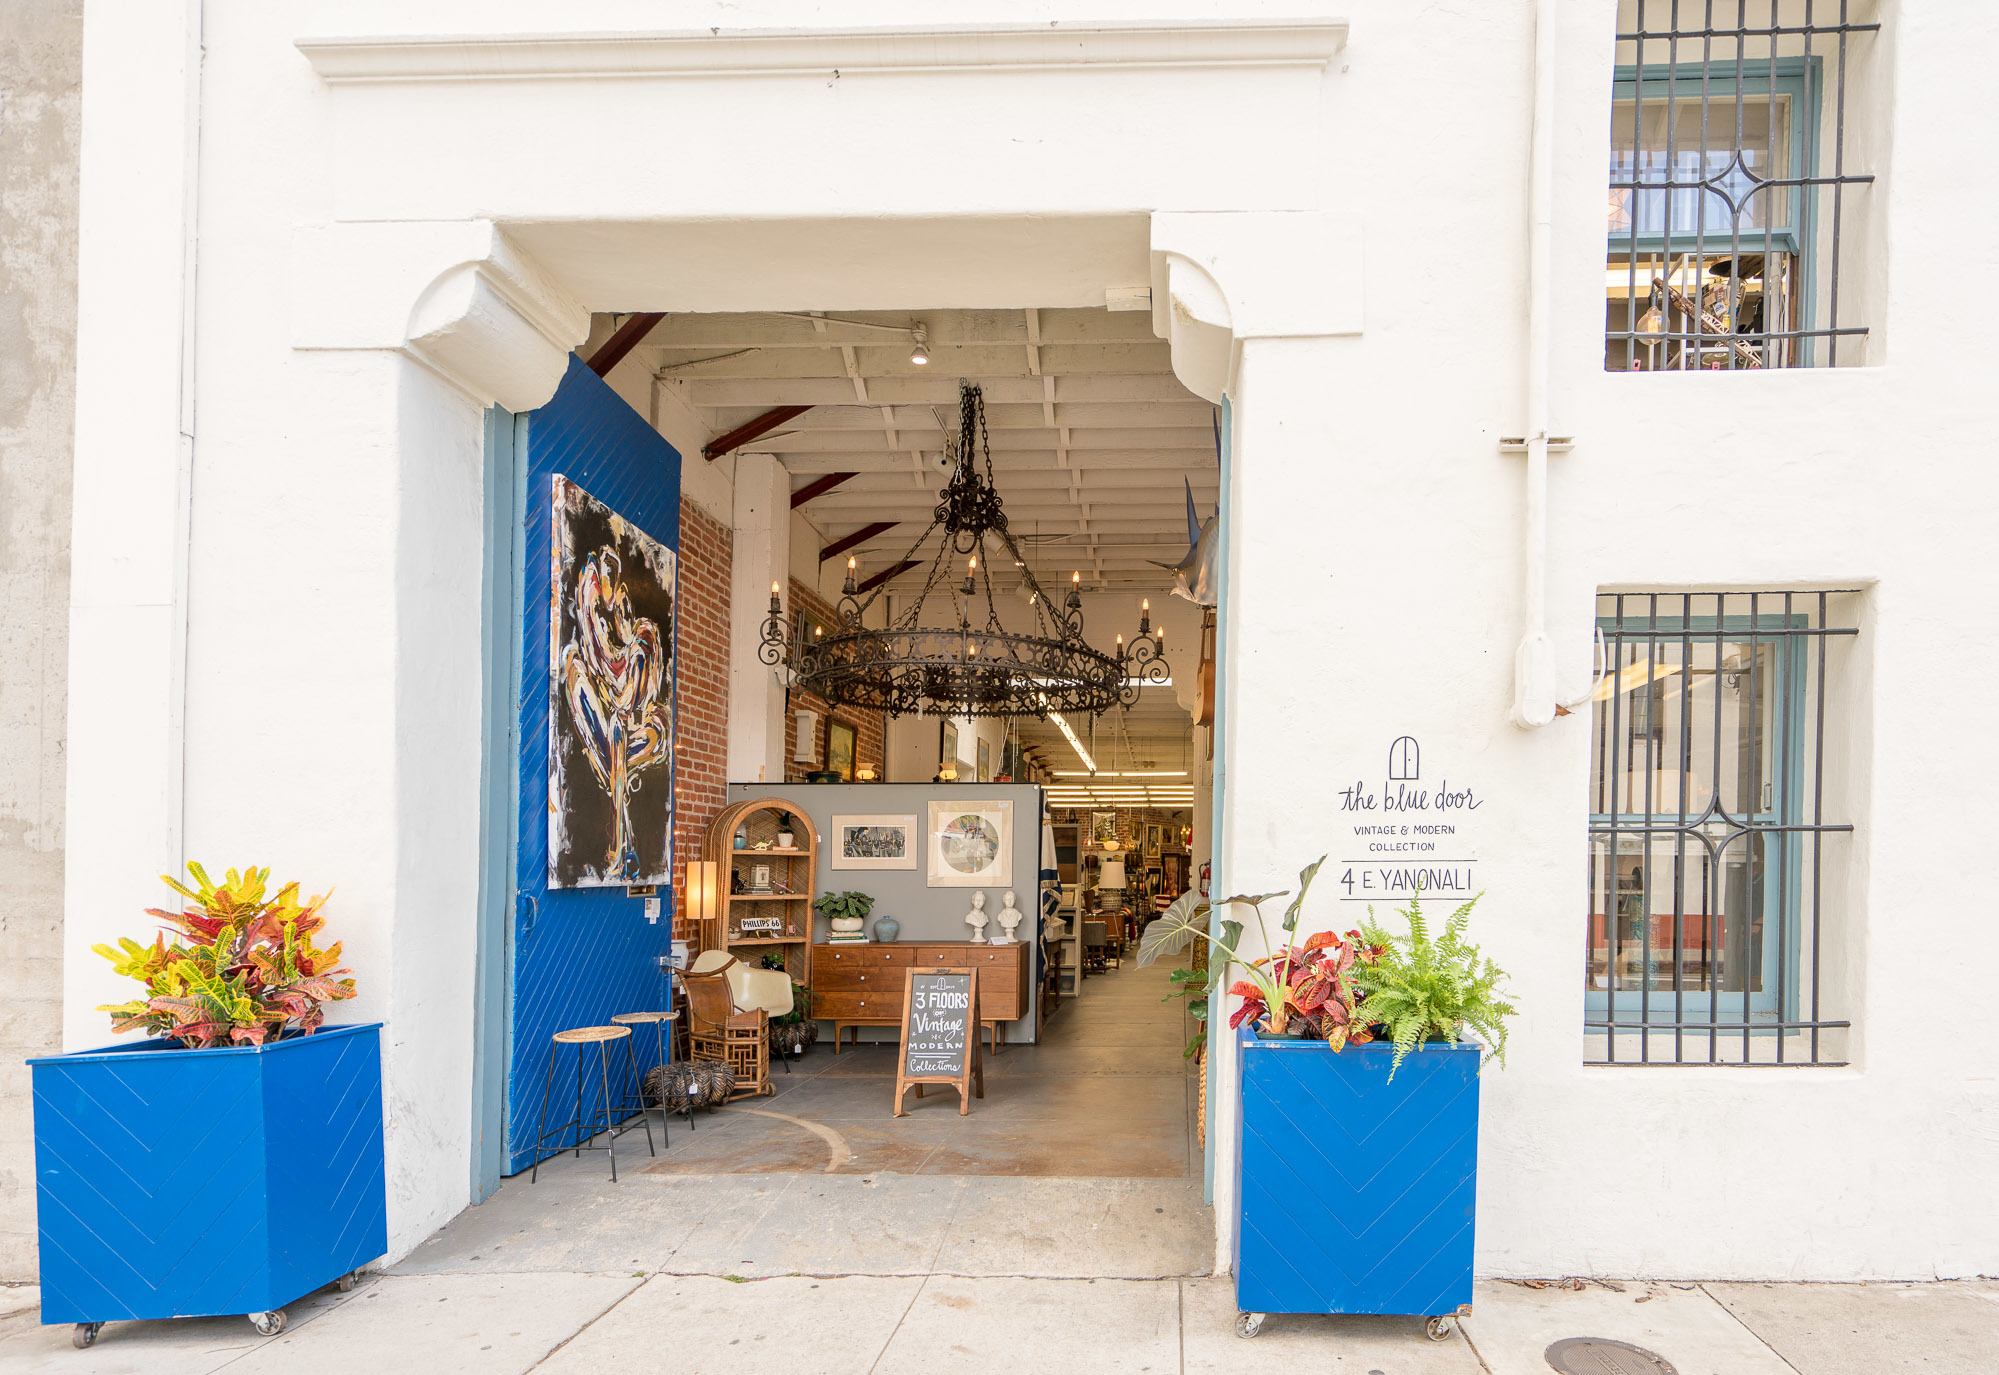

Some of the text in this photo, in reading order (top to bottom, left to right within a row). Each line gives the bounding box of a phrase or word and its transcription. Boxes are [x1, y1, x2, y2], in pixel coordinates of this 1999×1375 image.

[1338, 780, 1484, 812] the blue door
[1354, 825, 1456, 836] VINTAGE & MODERN
[1369, 842, 1435, 852] COLLECTION
[1340, 867, 1471, 895] 4 E. YANONALI
[742, 919, 780, 928] PHILLIPS 66
[915, 991, 969, 1009] 3 FLOORS
[913, 1013, 963, 1041] Vintage
[908, 1042, 963, 1050] MODERN
[910, 1058, 961, 1072] Collections
